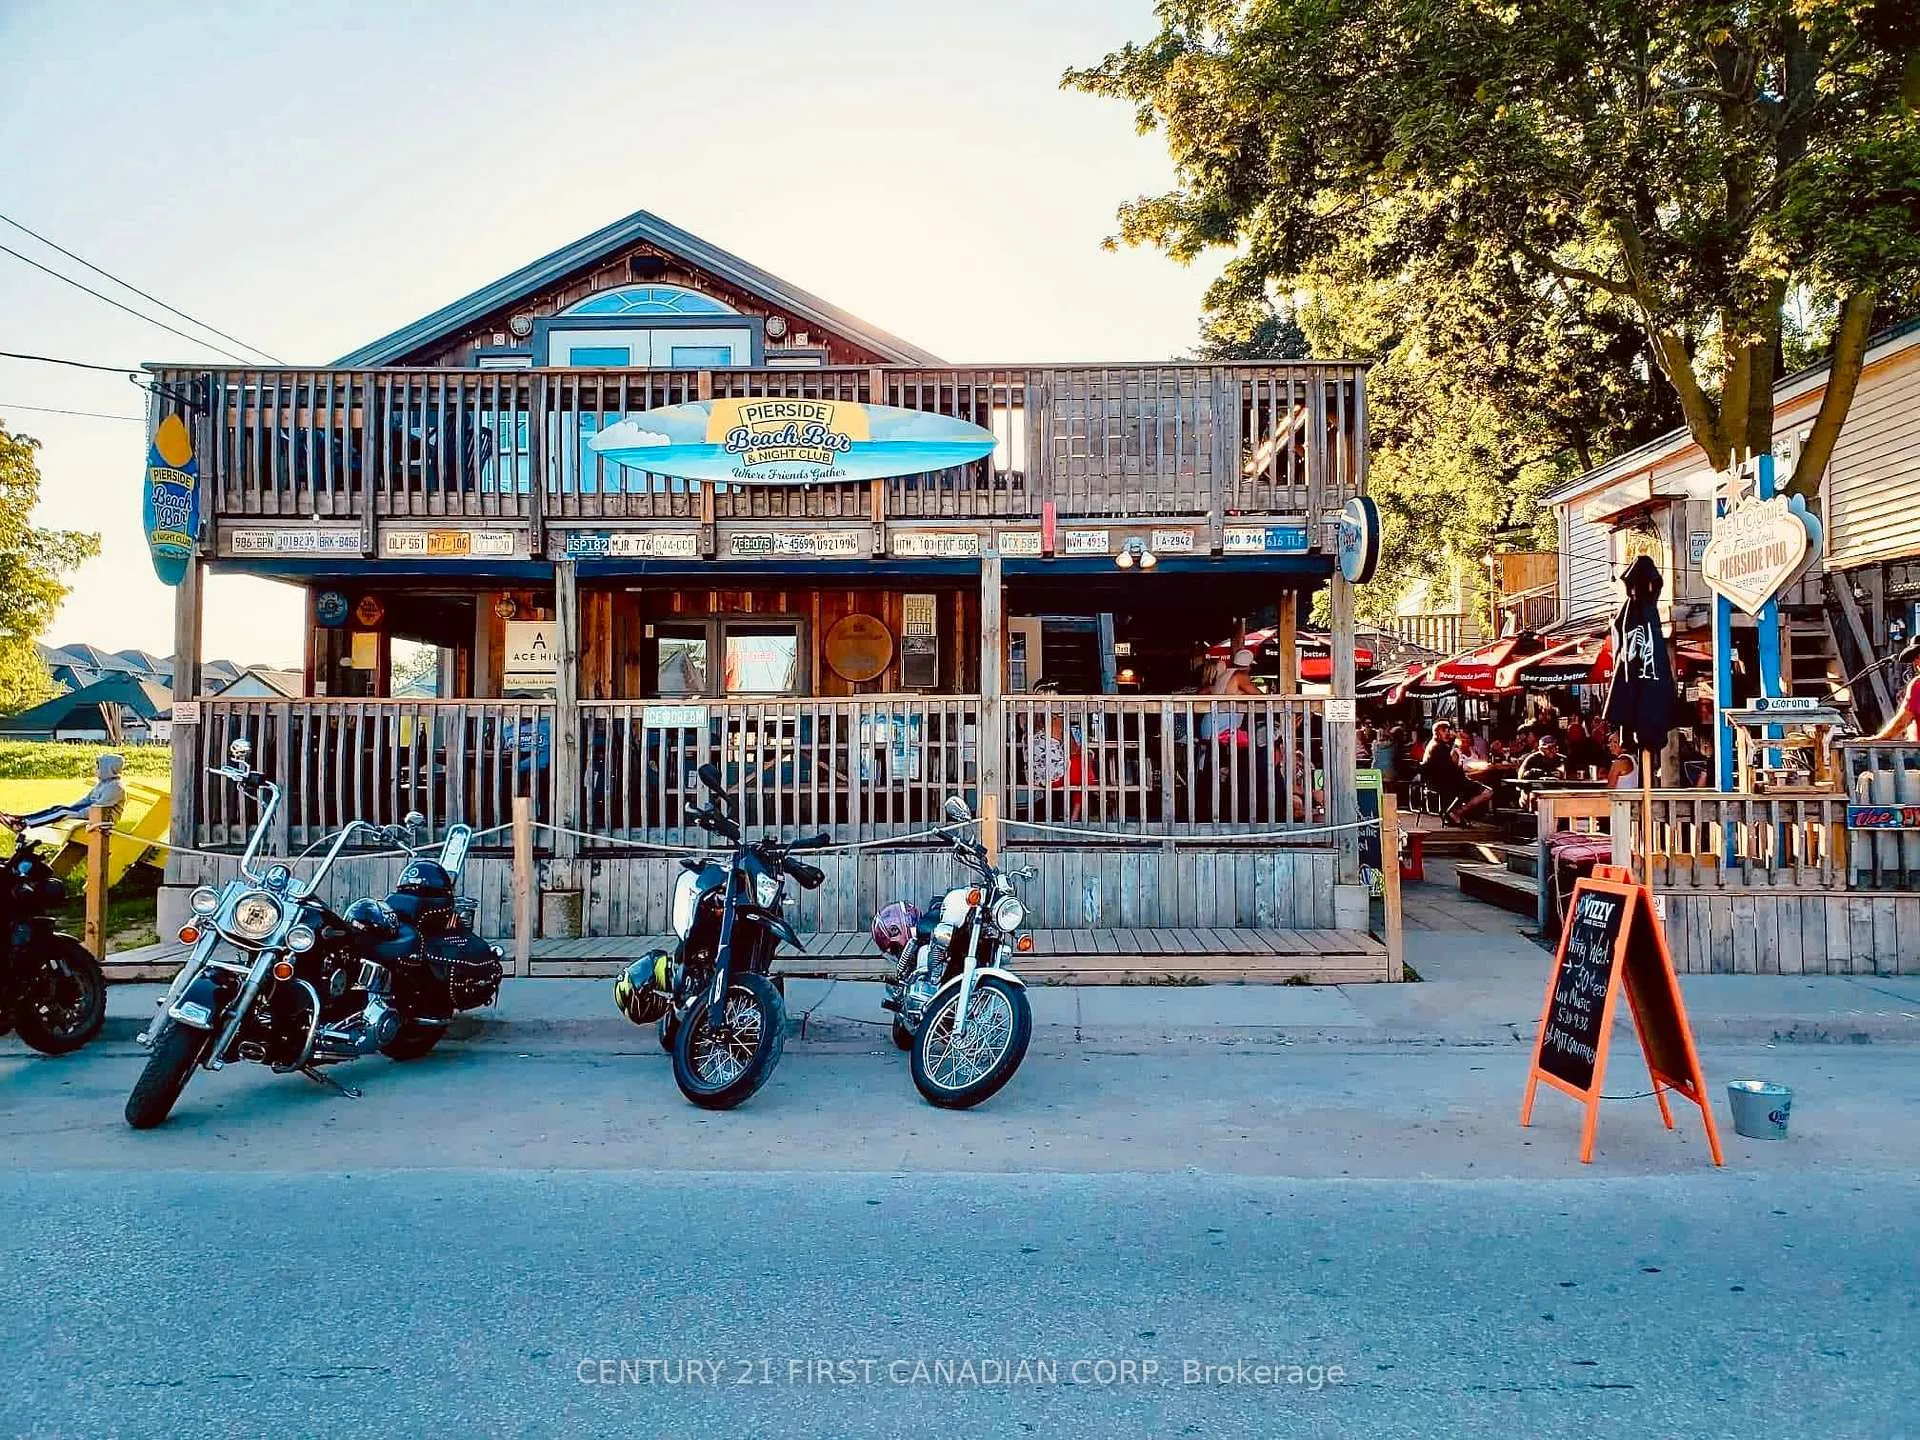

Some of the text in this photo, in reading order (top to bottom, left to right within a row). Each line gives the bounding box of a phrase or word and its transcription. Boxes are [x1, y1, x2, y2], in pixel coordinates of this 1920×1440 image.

[747, 404, 827, 421] PIERSIDE
[726, 422, 851, 453] Beach Bar
[747, 449, 830, 463] & NIGHT CLUB
[153, 469, 191, 488] PIERSIDE
[731, 466, 847, 481] Where Friends Gather
[152, 484, 193, 511] Beach
[159, 507, 187, 529] Bar
[1246, 535, 1262, 545] 946
[1720, 540, 1788, 580] PIERSIDE PUB
[514, 653, 558, 661] ACE HIL
[1771, 699, 1810, 709] Corona
[1584, 899, 1616, 922] VIZZY
